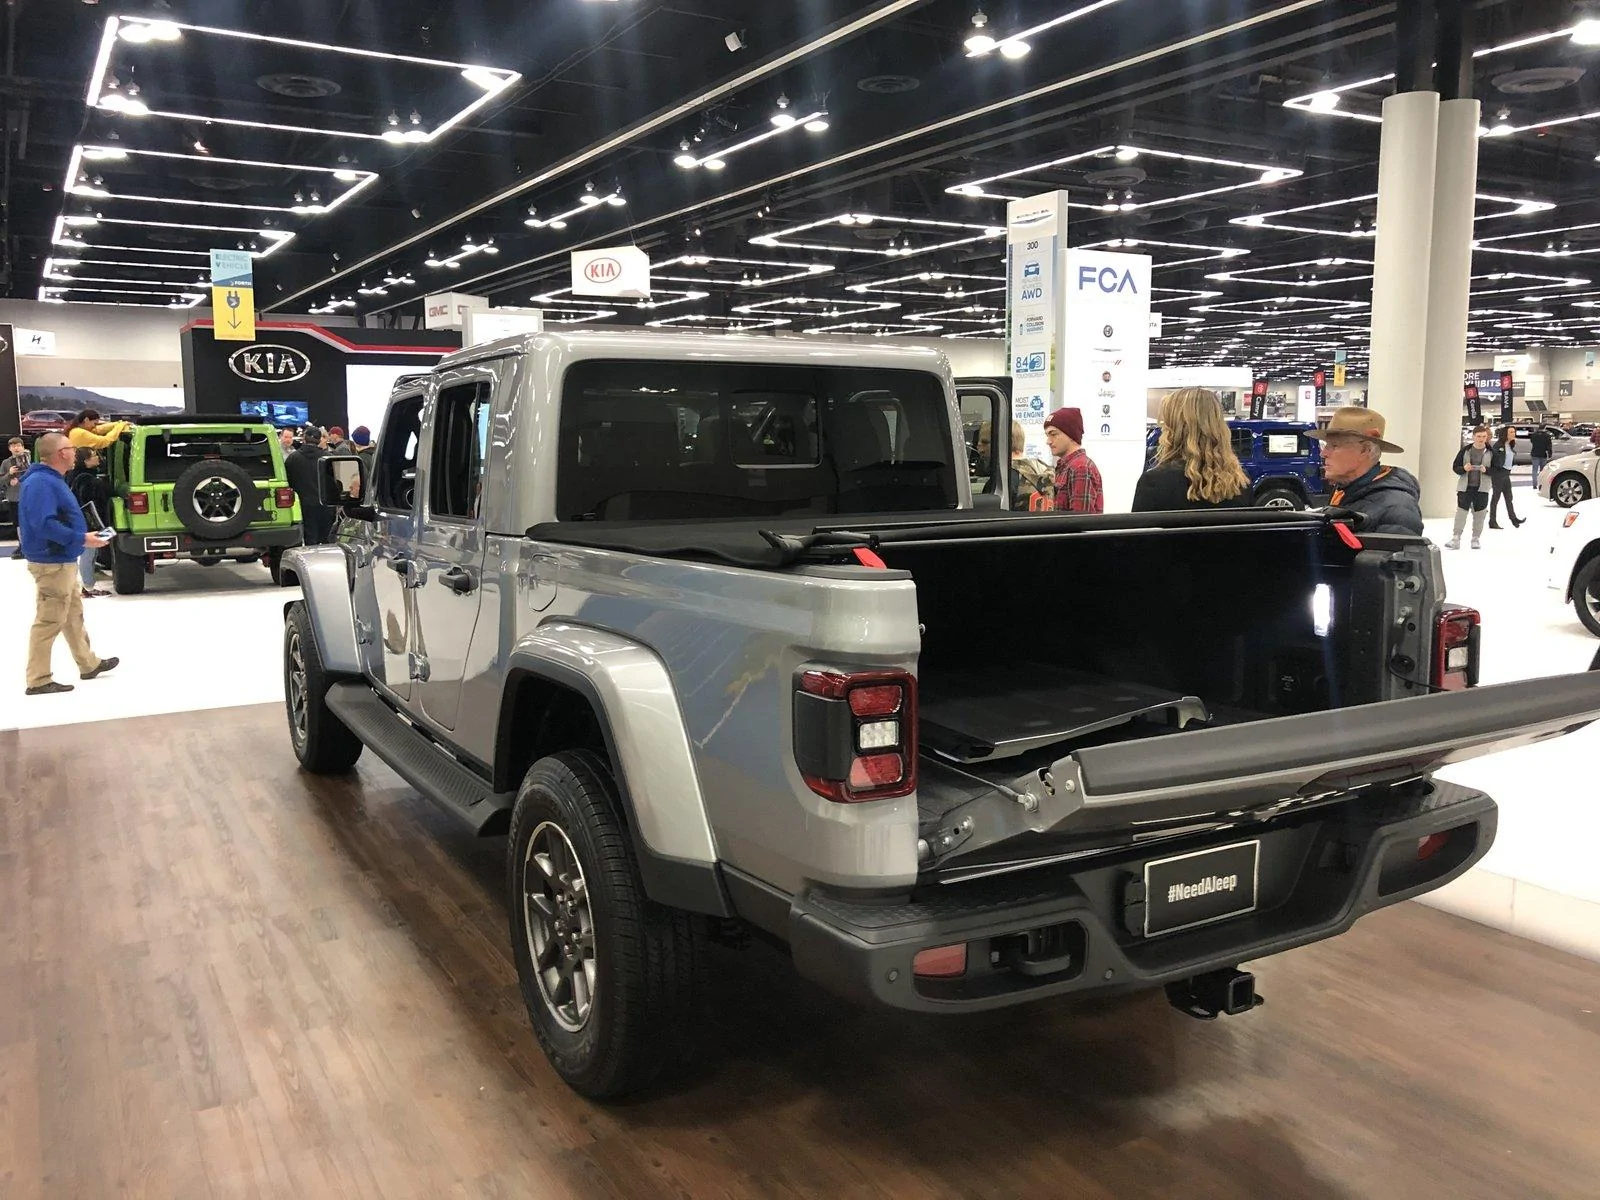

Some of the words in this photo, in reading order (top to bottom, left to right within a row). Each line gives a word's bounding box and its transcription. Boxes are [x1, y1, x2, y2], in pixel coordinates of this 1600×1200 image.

[1027, 241, 1038, 250] 300
[215, 253, 250, 261] ELECTRIC
[215, 261, 249, 269] VEHICLE
[591, 263, 615, 278] KIA
[1079, 266, 1138, 294] FCA
[1021, 288, 1042, 300] AWD
[428, 304, 448, 317] GMC
[243, 352, 298, 374] KIA
[1253, 396, 1262, 417] Camry
[1167, 874, 1238, 903] #NeedAJeep
